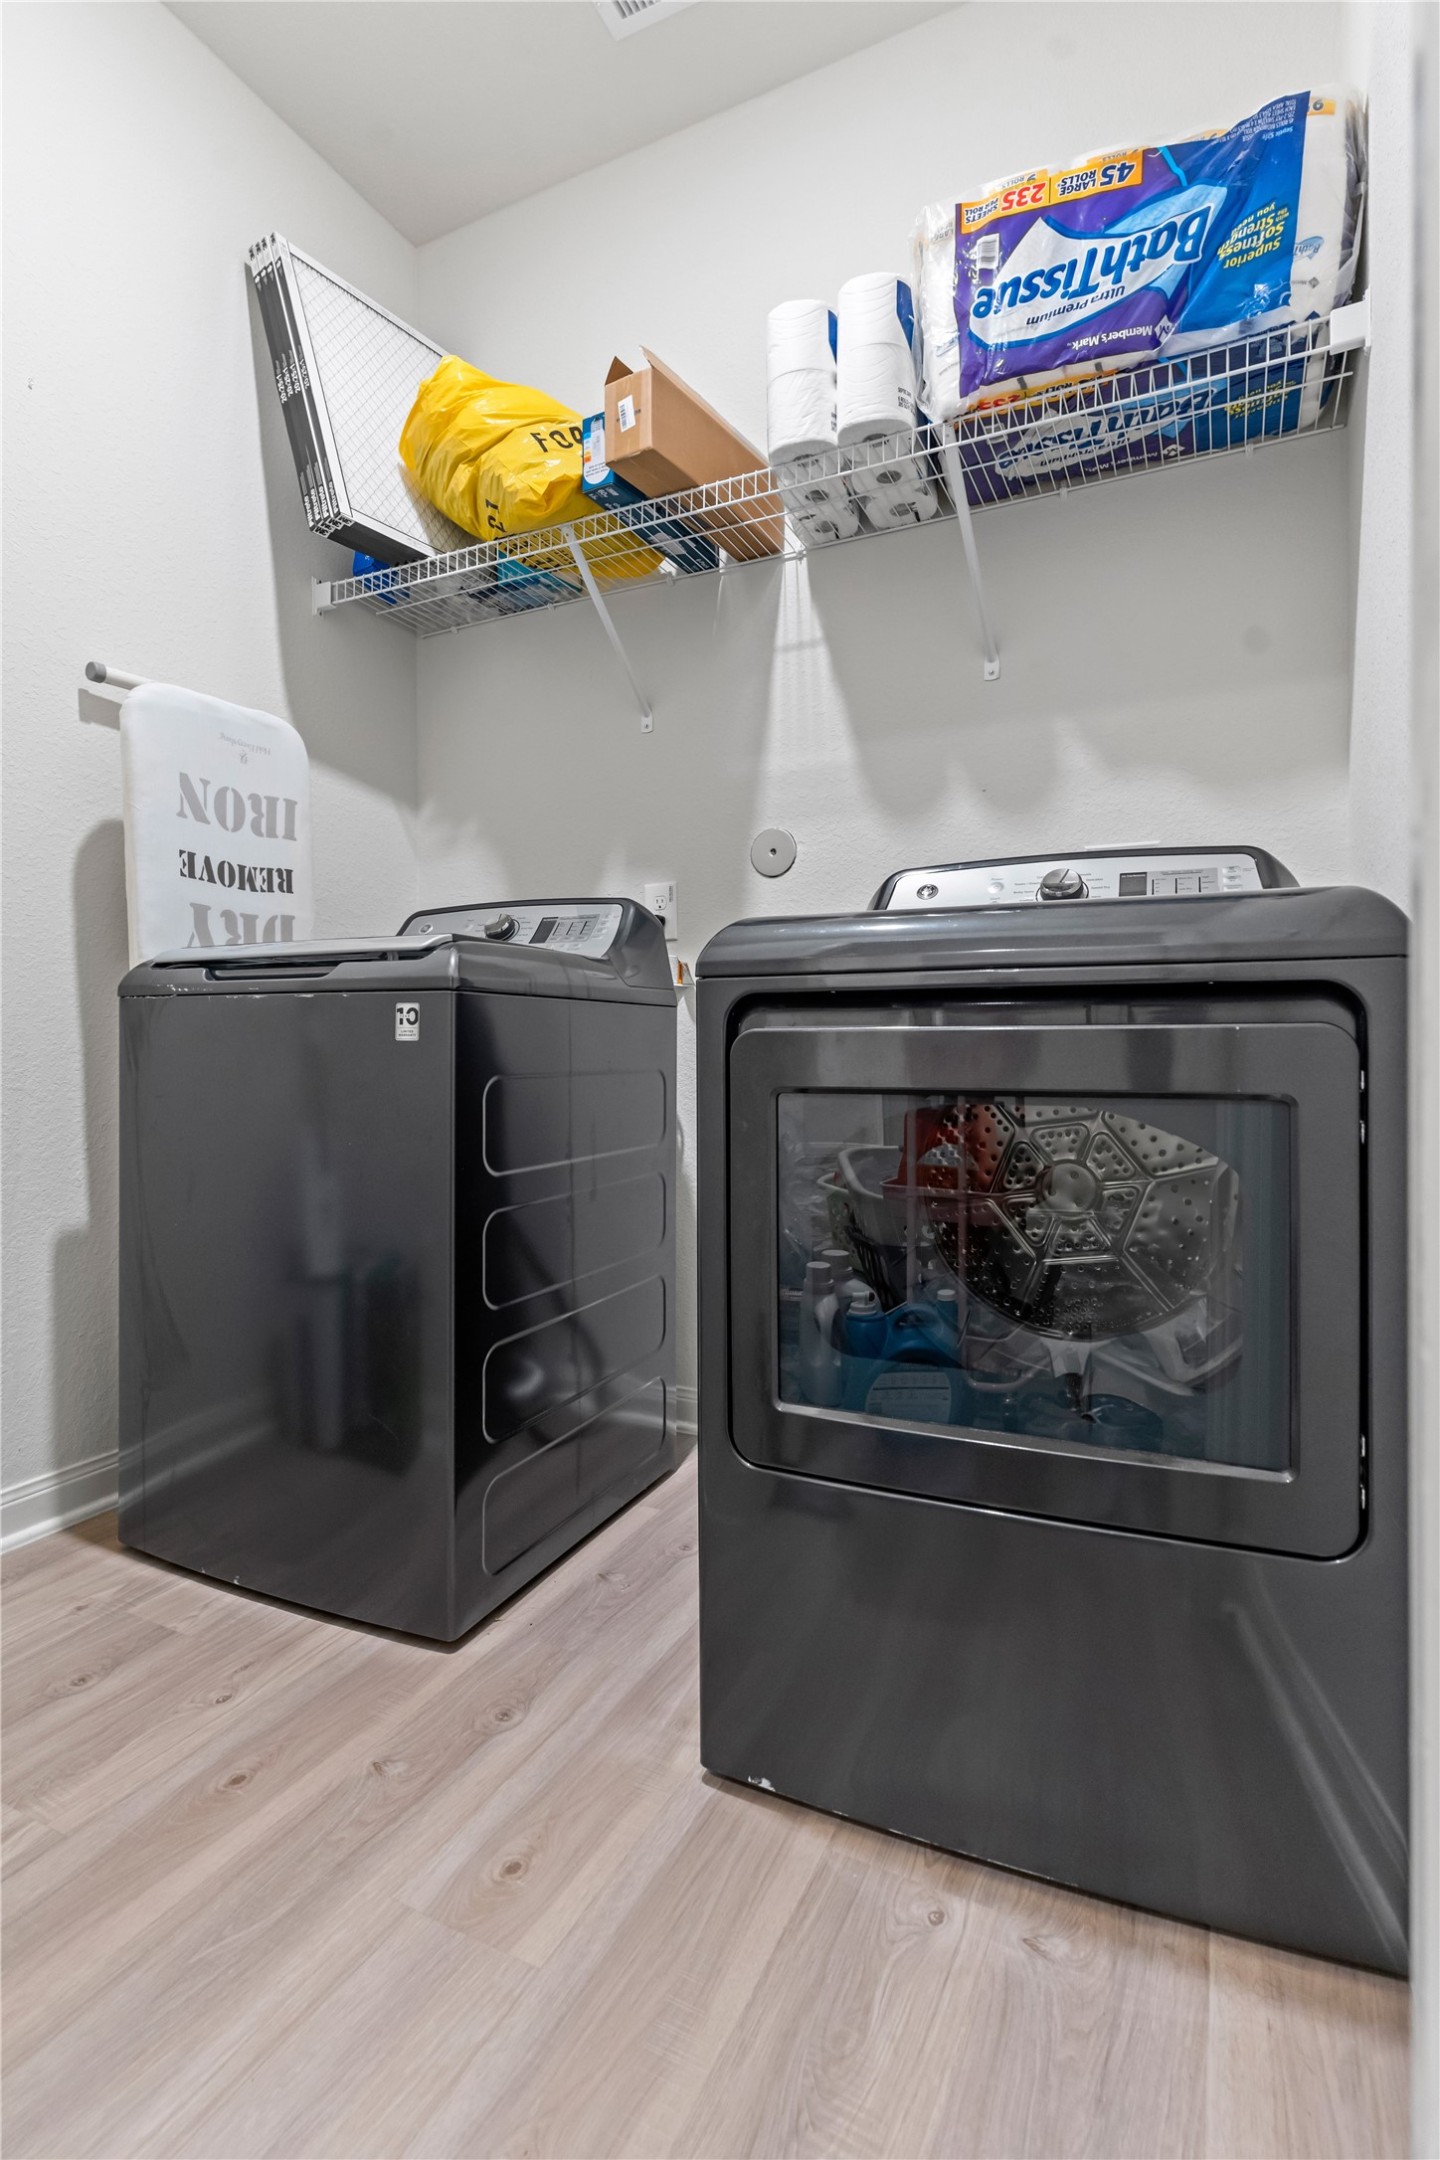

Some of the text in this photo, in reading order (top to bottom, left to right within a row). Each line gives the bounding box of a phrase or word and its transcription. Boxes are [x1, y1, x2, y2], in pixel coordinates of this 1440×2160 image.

[1099, 161, 1136, 187] 45
[1001, 182, 1047, 211] 235
[1059, 178, 1097, 197] LARGE
[964, 198, 999, 216] PER ROLL
[965, 204, 998, 224] SHEETS
[1257, 202, 1276, 217] you
[1026, 285, 1126, 326] Ultra Premium
[1101, 324, 1153, 342] Member's
[176, 771, 298, 841] IRON
[178, 849, 295, 894] REMOVE
[187, 902, 296, 948] DRY
